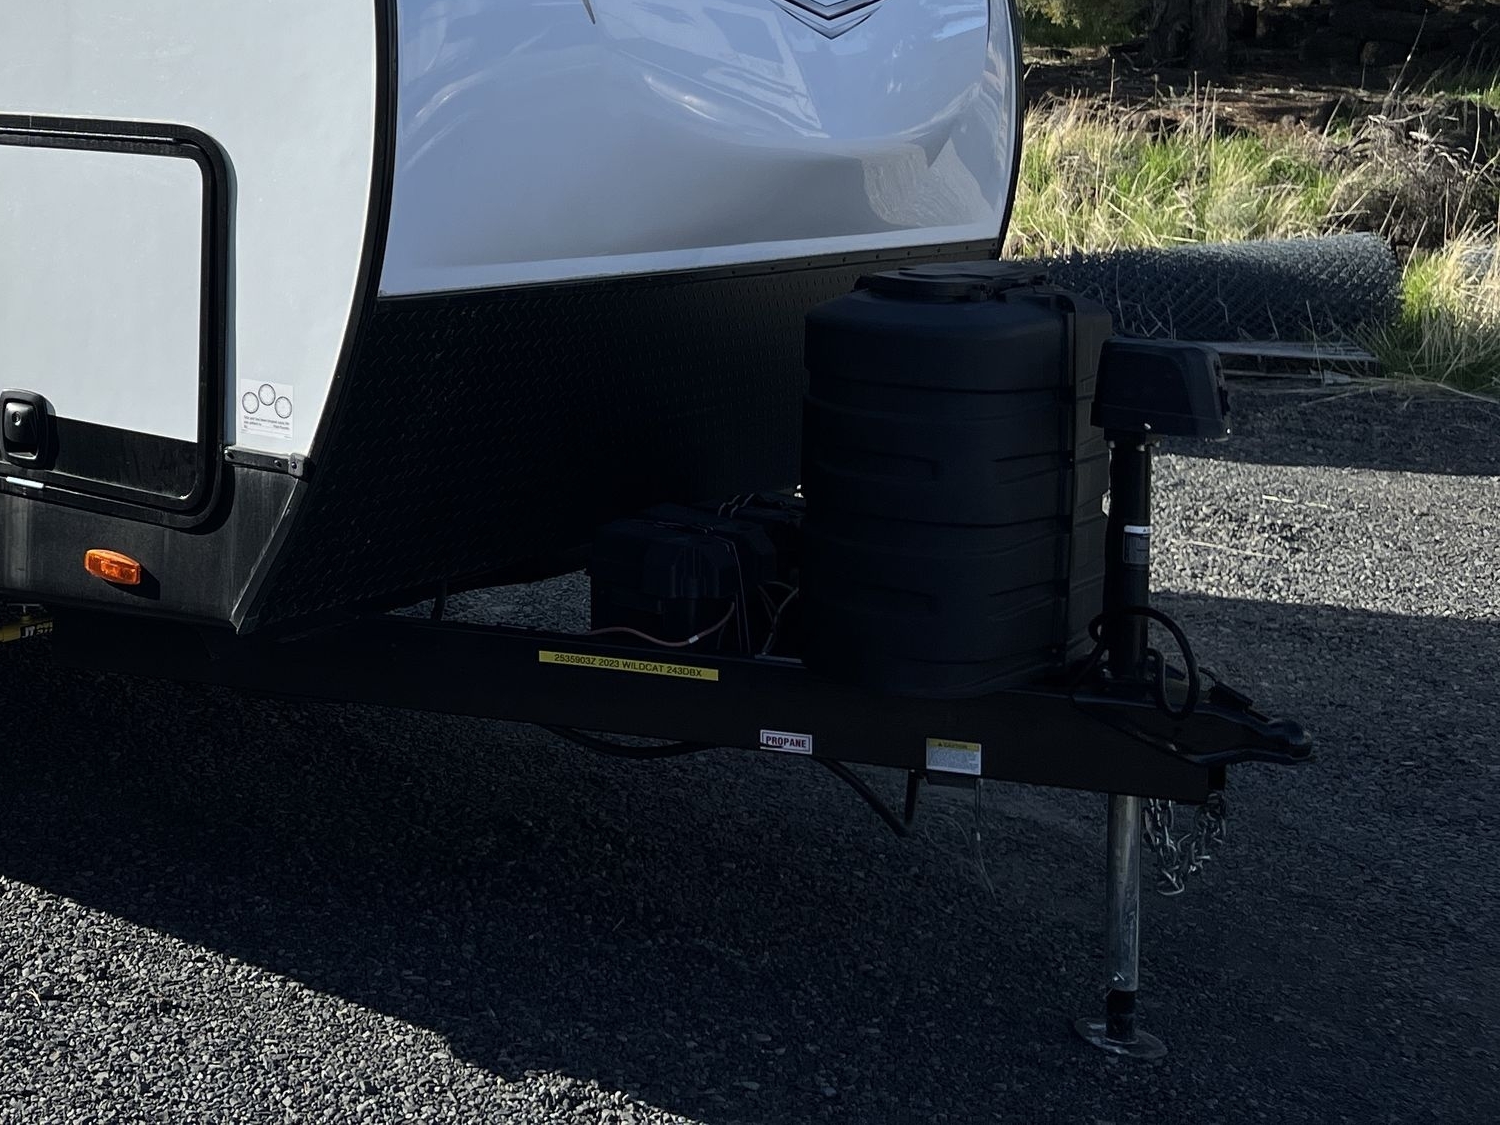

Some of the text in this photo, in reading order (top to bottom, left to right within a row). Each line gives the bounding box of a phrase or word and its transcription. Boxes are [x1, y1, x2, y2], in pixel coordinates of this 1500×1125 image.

[598, 658, 619, 668] 2023
[622, 660, 664, 673] WILDCAT
[666, 665, 702, 677] 243DBX
[765, 735, 807, 749] PROPANE
